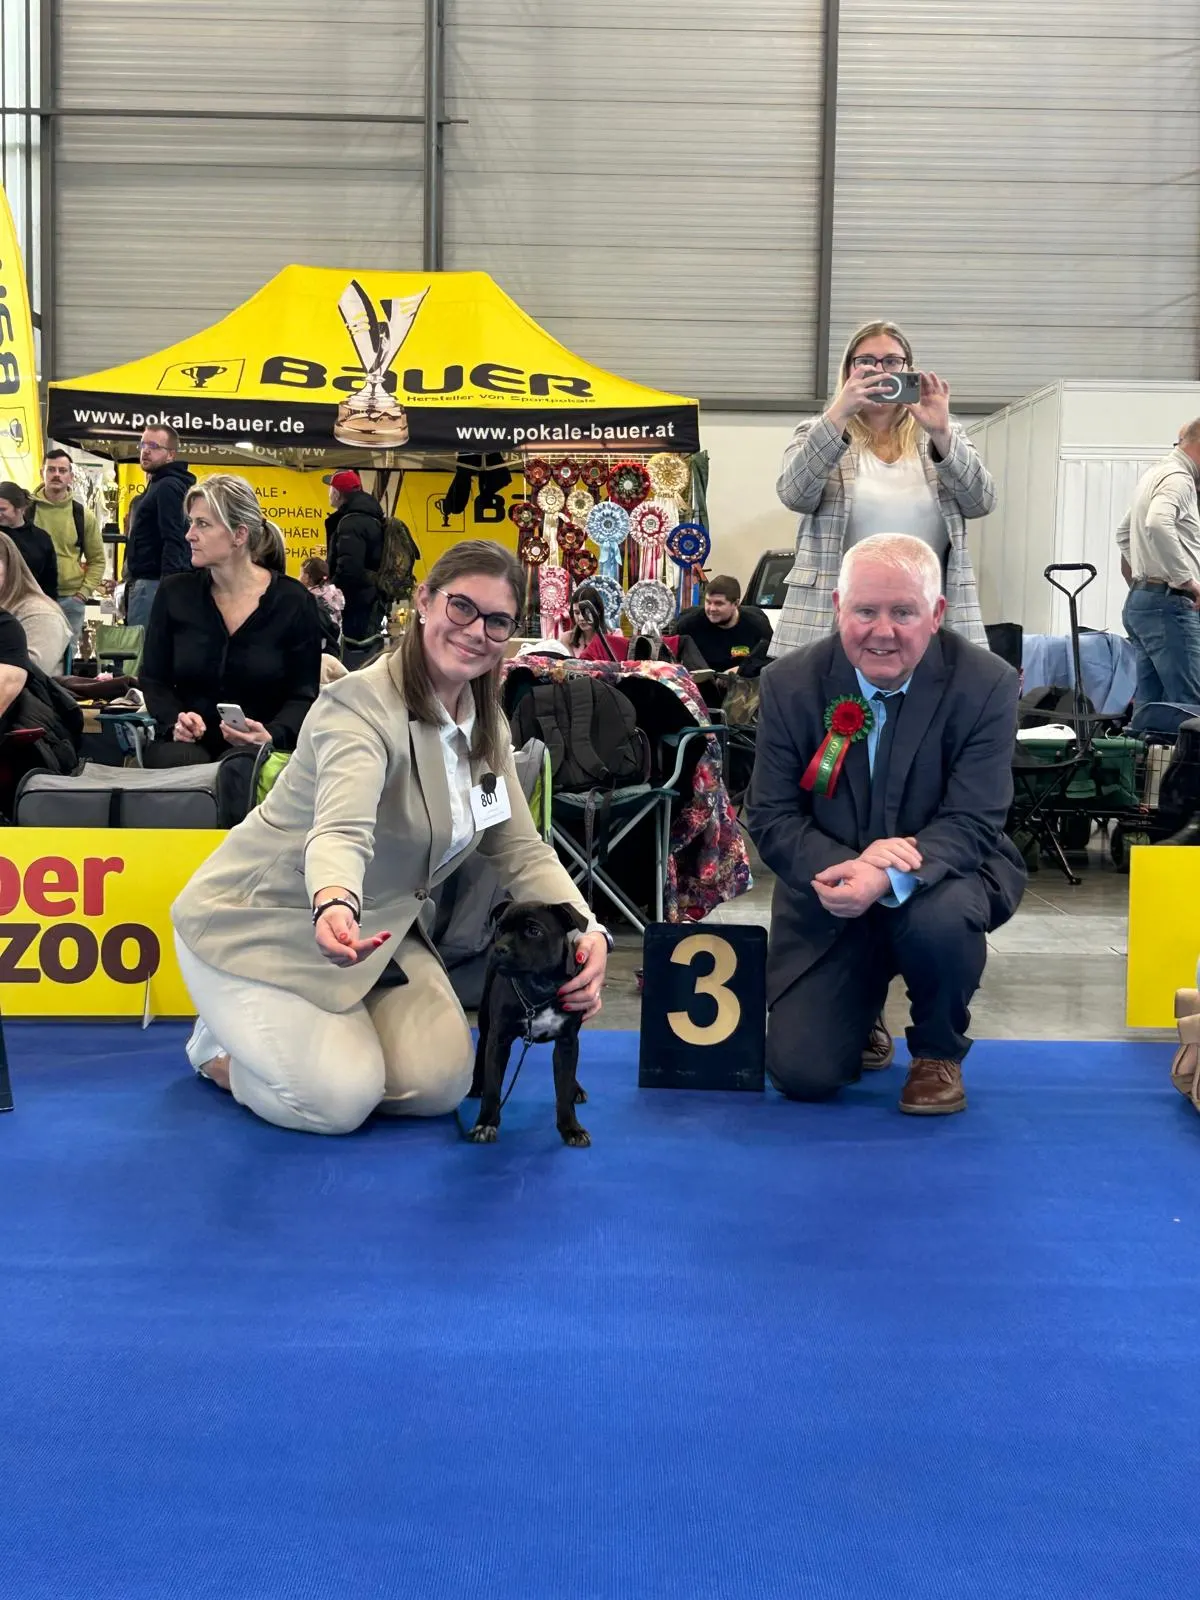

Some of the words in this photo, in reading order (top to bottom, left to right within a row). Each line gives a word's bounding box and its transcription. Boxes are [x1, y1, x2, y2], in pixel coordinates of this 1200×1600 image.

[73, 409, 305, 434] www.pokale-bauer.de
[456, 422, 675, 443] www.pokale-bauer.at
[280, 526, 320, 539] HÄEN
[480, 790, 498, 807] 801
[0, 923, 160, 984] zoo
[666, 933, 741, 1046] 3
